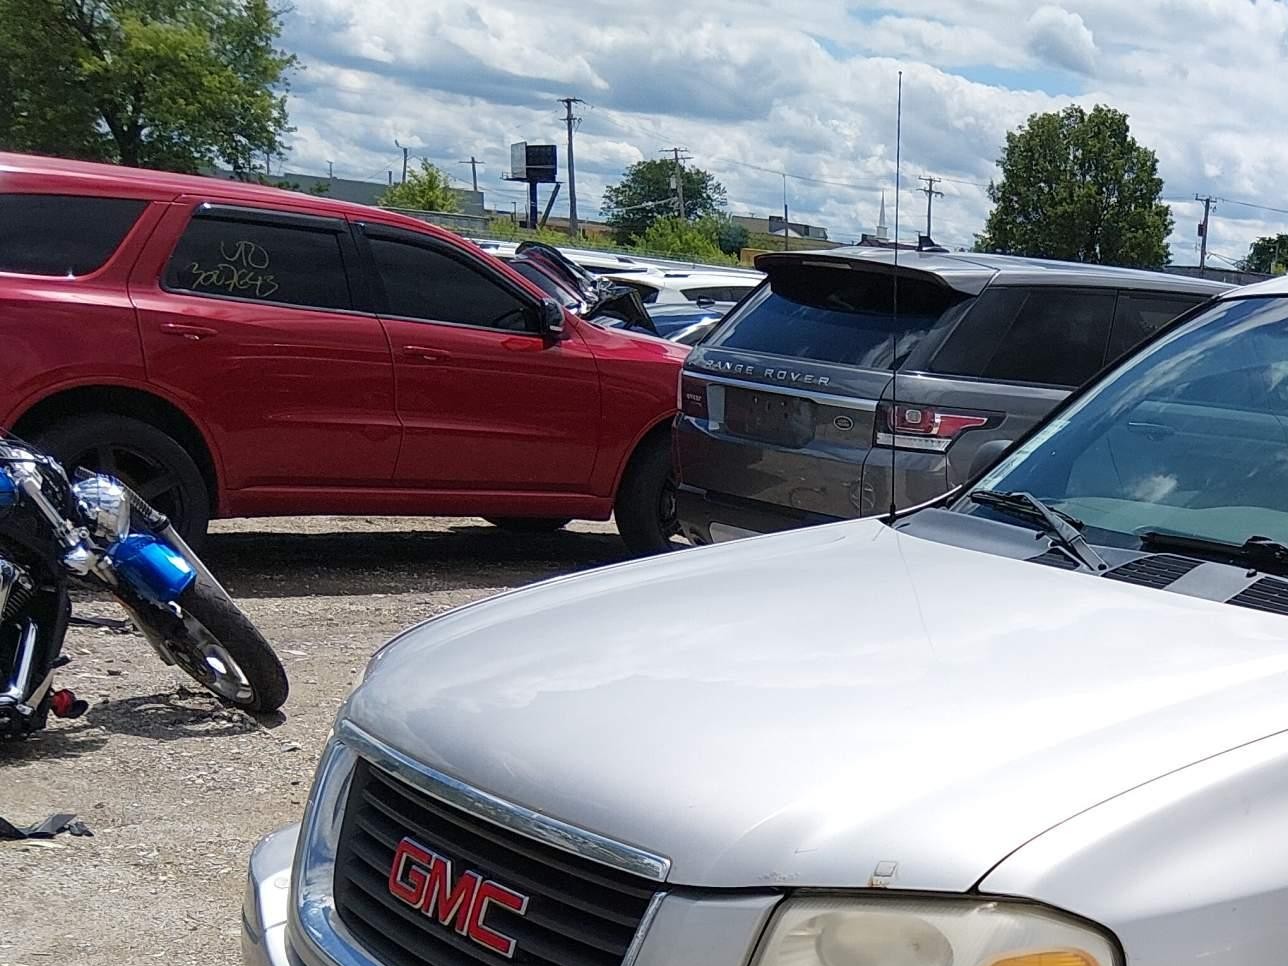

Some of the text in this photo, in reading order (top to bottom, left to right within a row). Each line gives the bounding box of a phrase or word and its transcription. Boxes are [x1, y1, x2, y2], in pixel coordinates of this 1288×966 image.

[704, 360, 831, 386] RANGE ROVER
[388, 836, 530, 959] GMC
